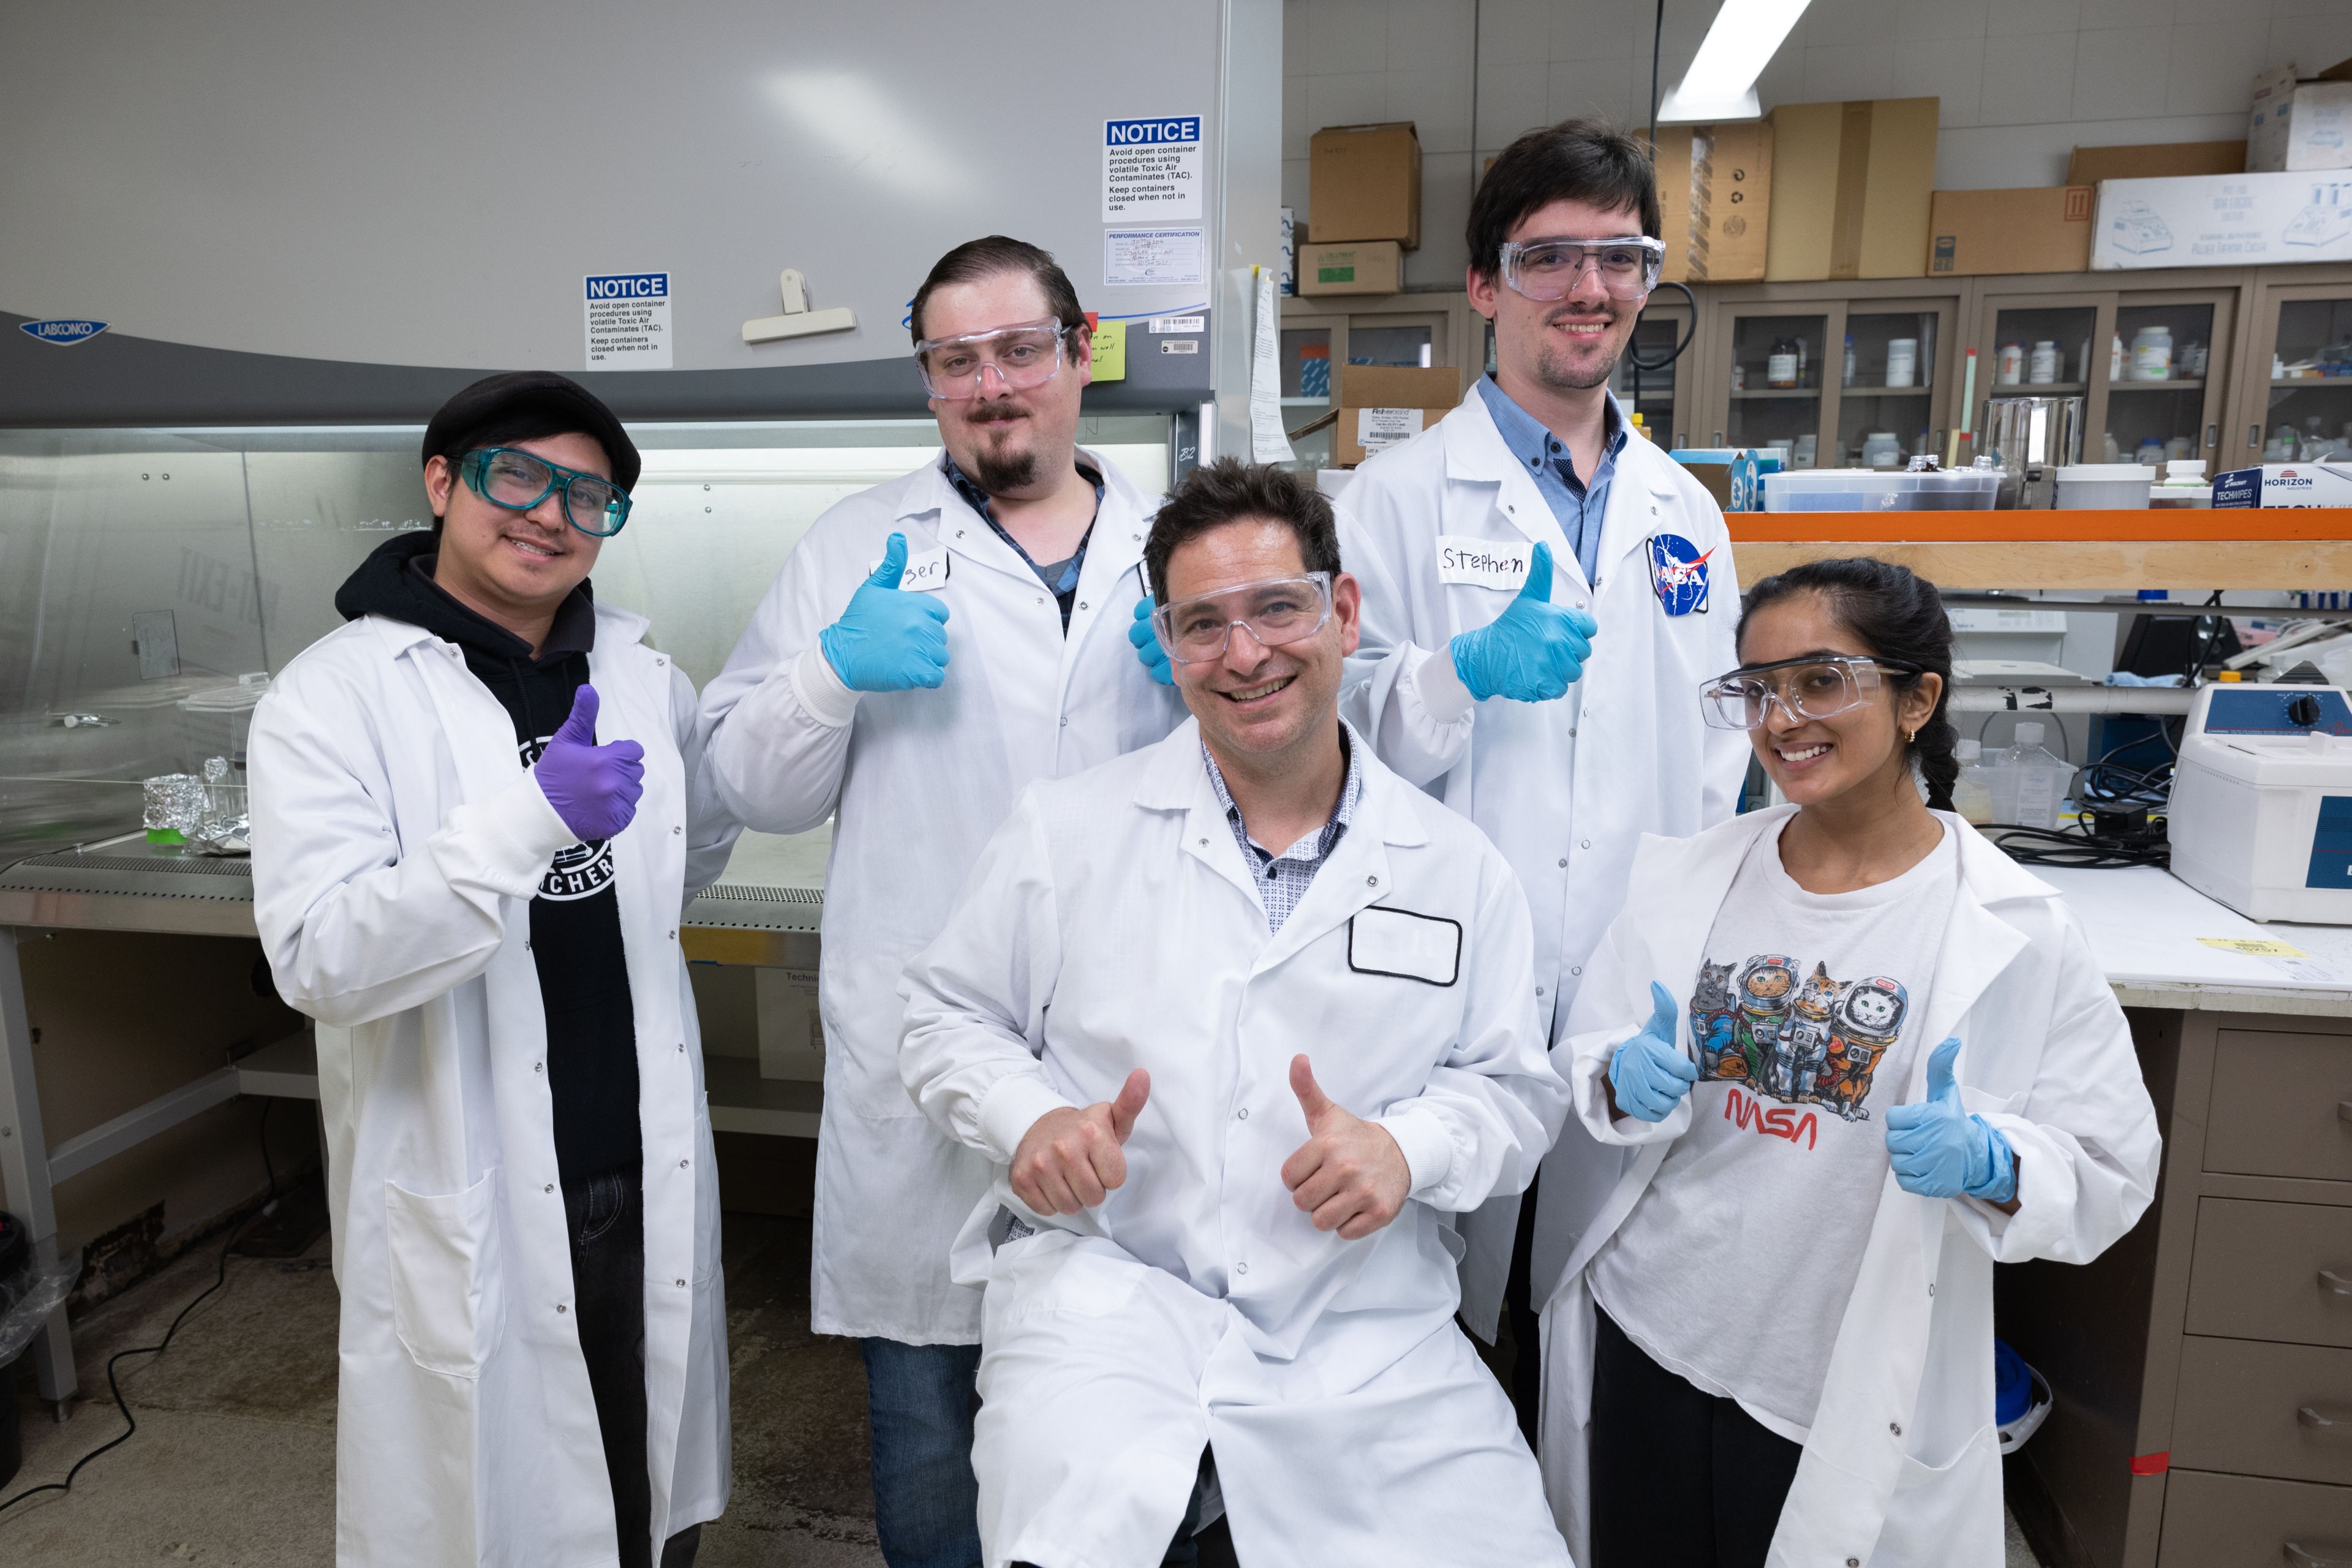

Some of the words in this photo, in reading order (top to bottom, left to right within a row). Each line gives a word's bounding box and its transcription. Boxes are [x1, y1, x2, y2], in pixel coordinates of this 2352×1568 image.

[1111, 122, 1194, 143] NOTICE
[1158, 146, 1196, 154] container
[1110, 156, 1155, 165] procedures
[1109, 173, 1164, 182] Contaminates
[1167, 172, 1192, 181] (TAC).
[590, 278, 663, 297] NOTICE
[38, 323, 92, 336] LABCONCO
[2217, 489, 2252, 500] TECHWIPES
[1443, 548, 1523, 573] Stephen
[905, 561, 940, 585] ger
[540, 850, 613, 892] CHER
[1725, 1088, 1817, 1151] NASA
